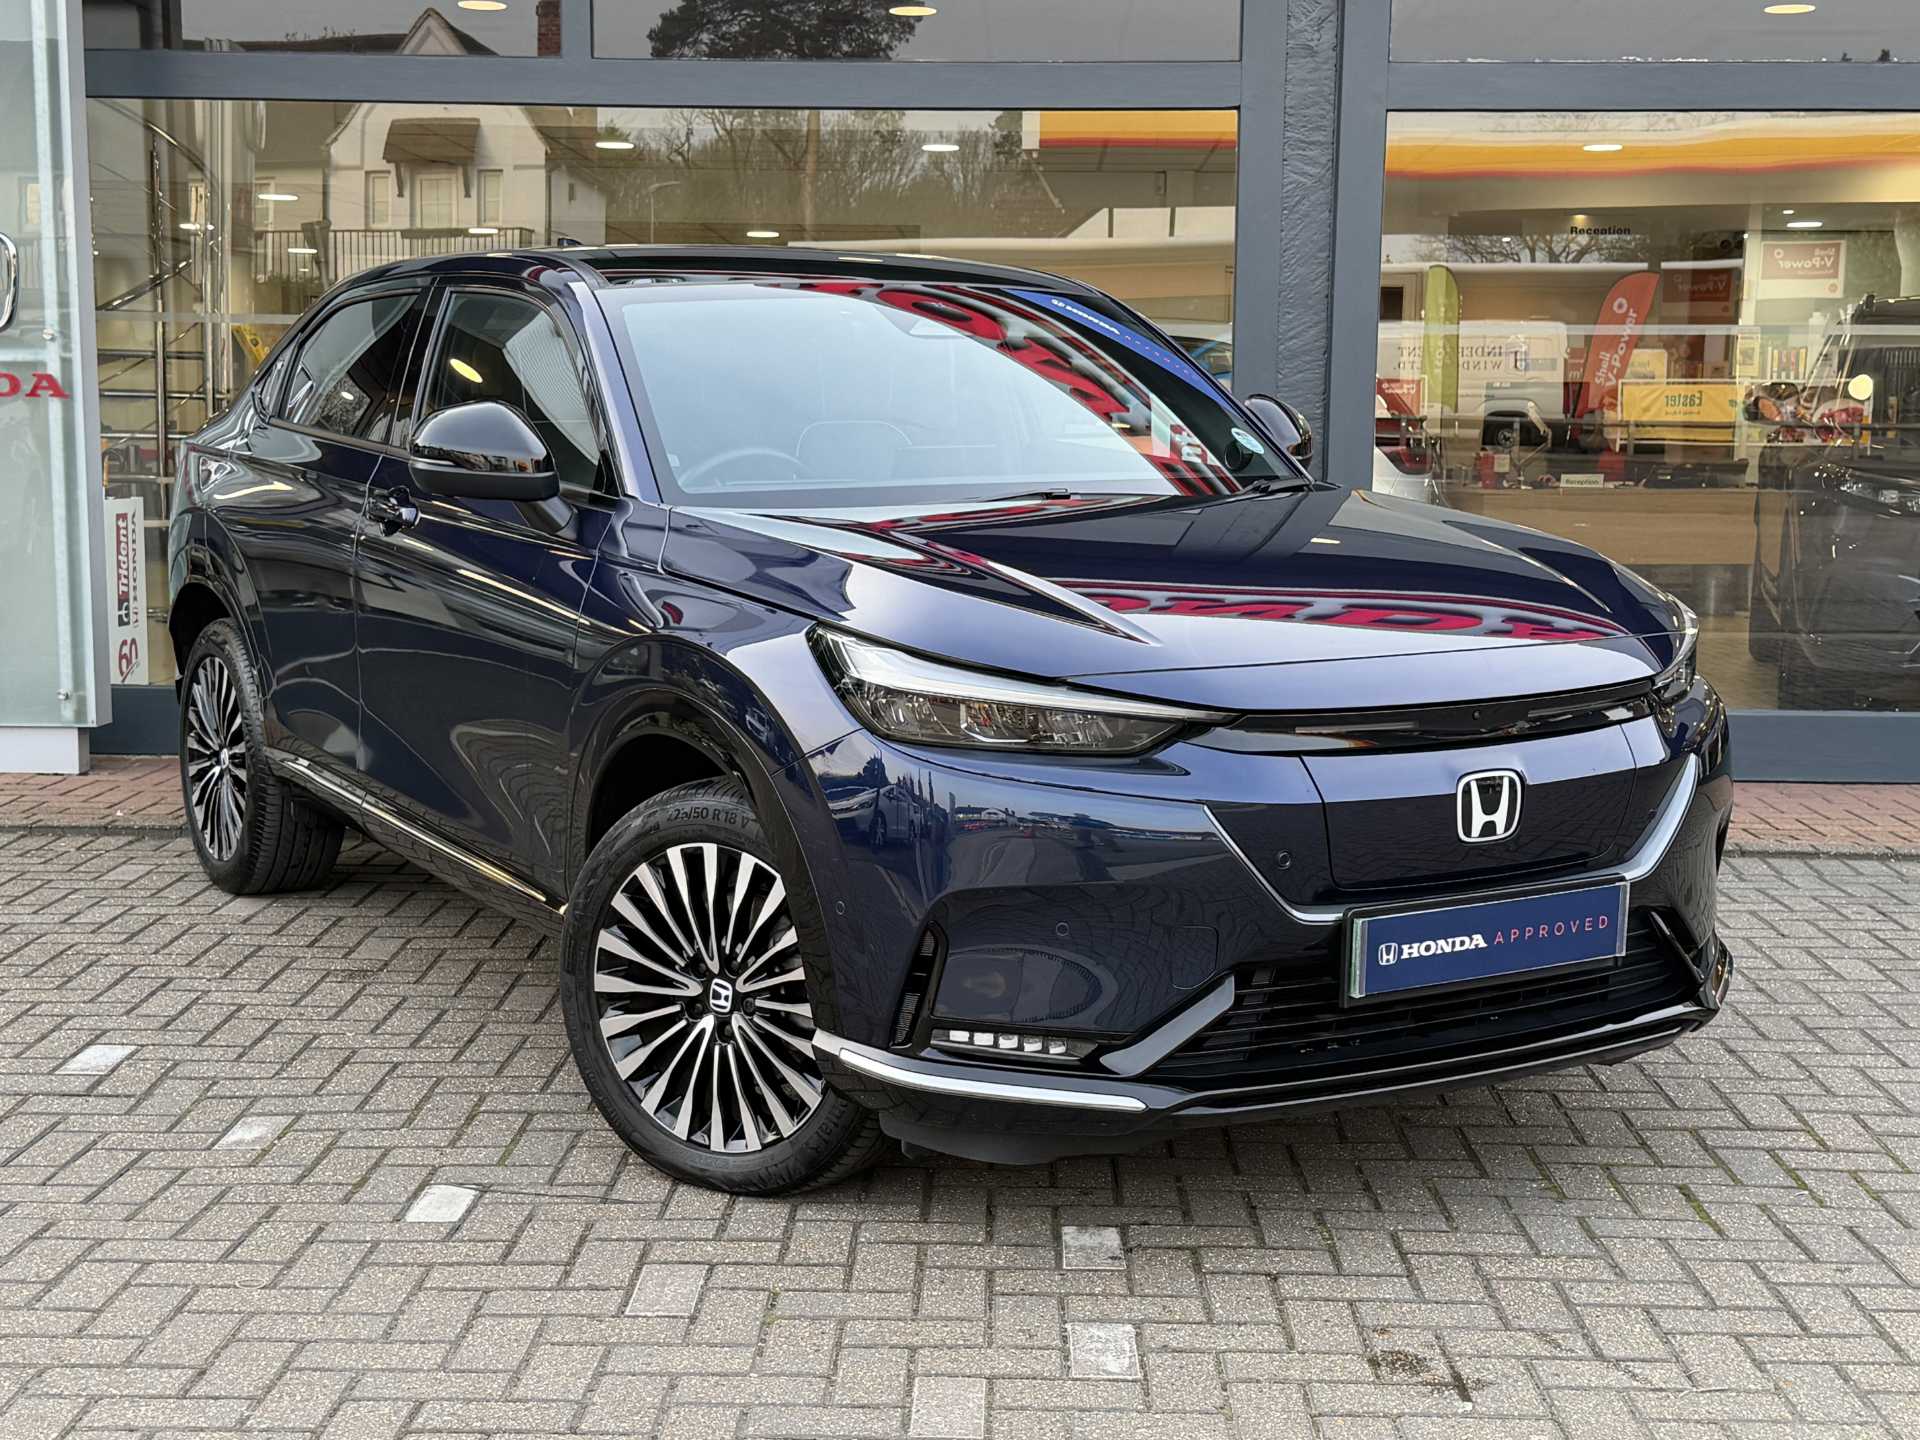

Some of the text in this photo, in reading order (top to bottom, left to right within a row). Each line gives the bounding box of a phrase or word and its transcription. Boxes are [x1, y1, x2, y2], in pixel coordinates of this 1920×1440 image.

[1570, 225, 1632, 235] Reception
[117, 517, 129, 595] Trident
[1401, 934, 1488, 959] HONDA
[1494, 915, 1609, 945] APPROVED
